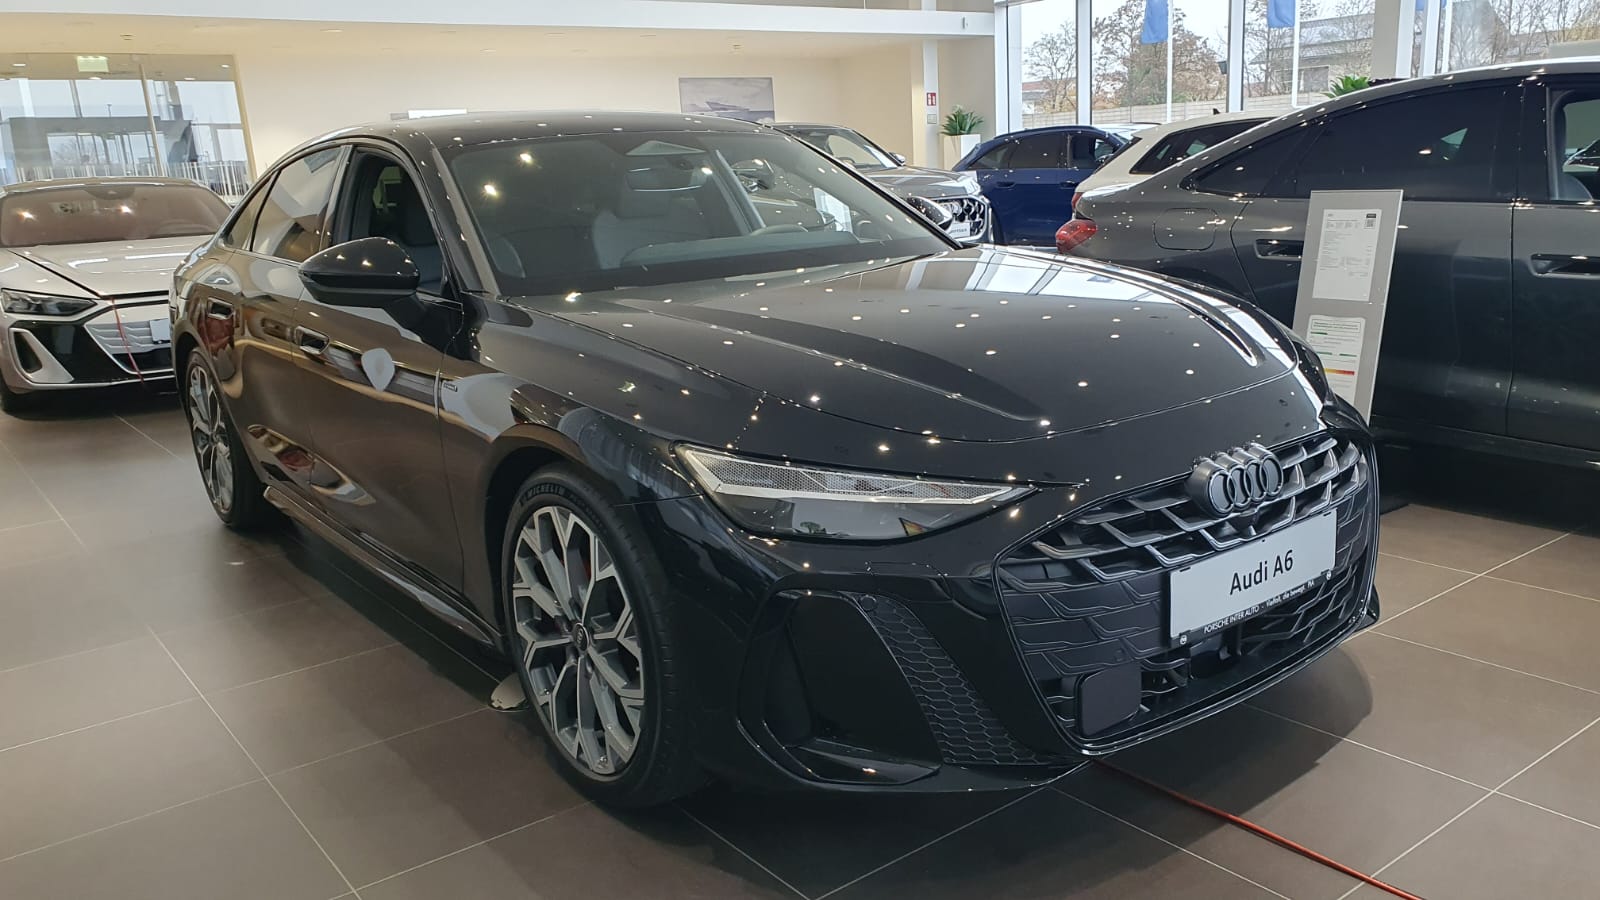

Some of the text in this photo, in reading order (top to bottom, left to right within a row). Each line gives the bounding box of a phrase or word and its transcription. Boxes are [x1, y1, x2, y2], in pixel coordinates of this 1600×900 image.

[528, 484, 565, 497] MICHELIN
[1230, 549, 1293, 595] Audi A6
[1203, 617, 1229, 634] PORSCHE
[1230, 611, 1244, 623] INTER
[1245, 605, 1260, 617] AUTO
